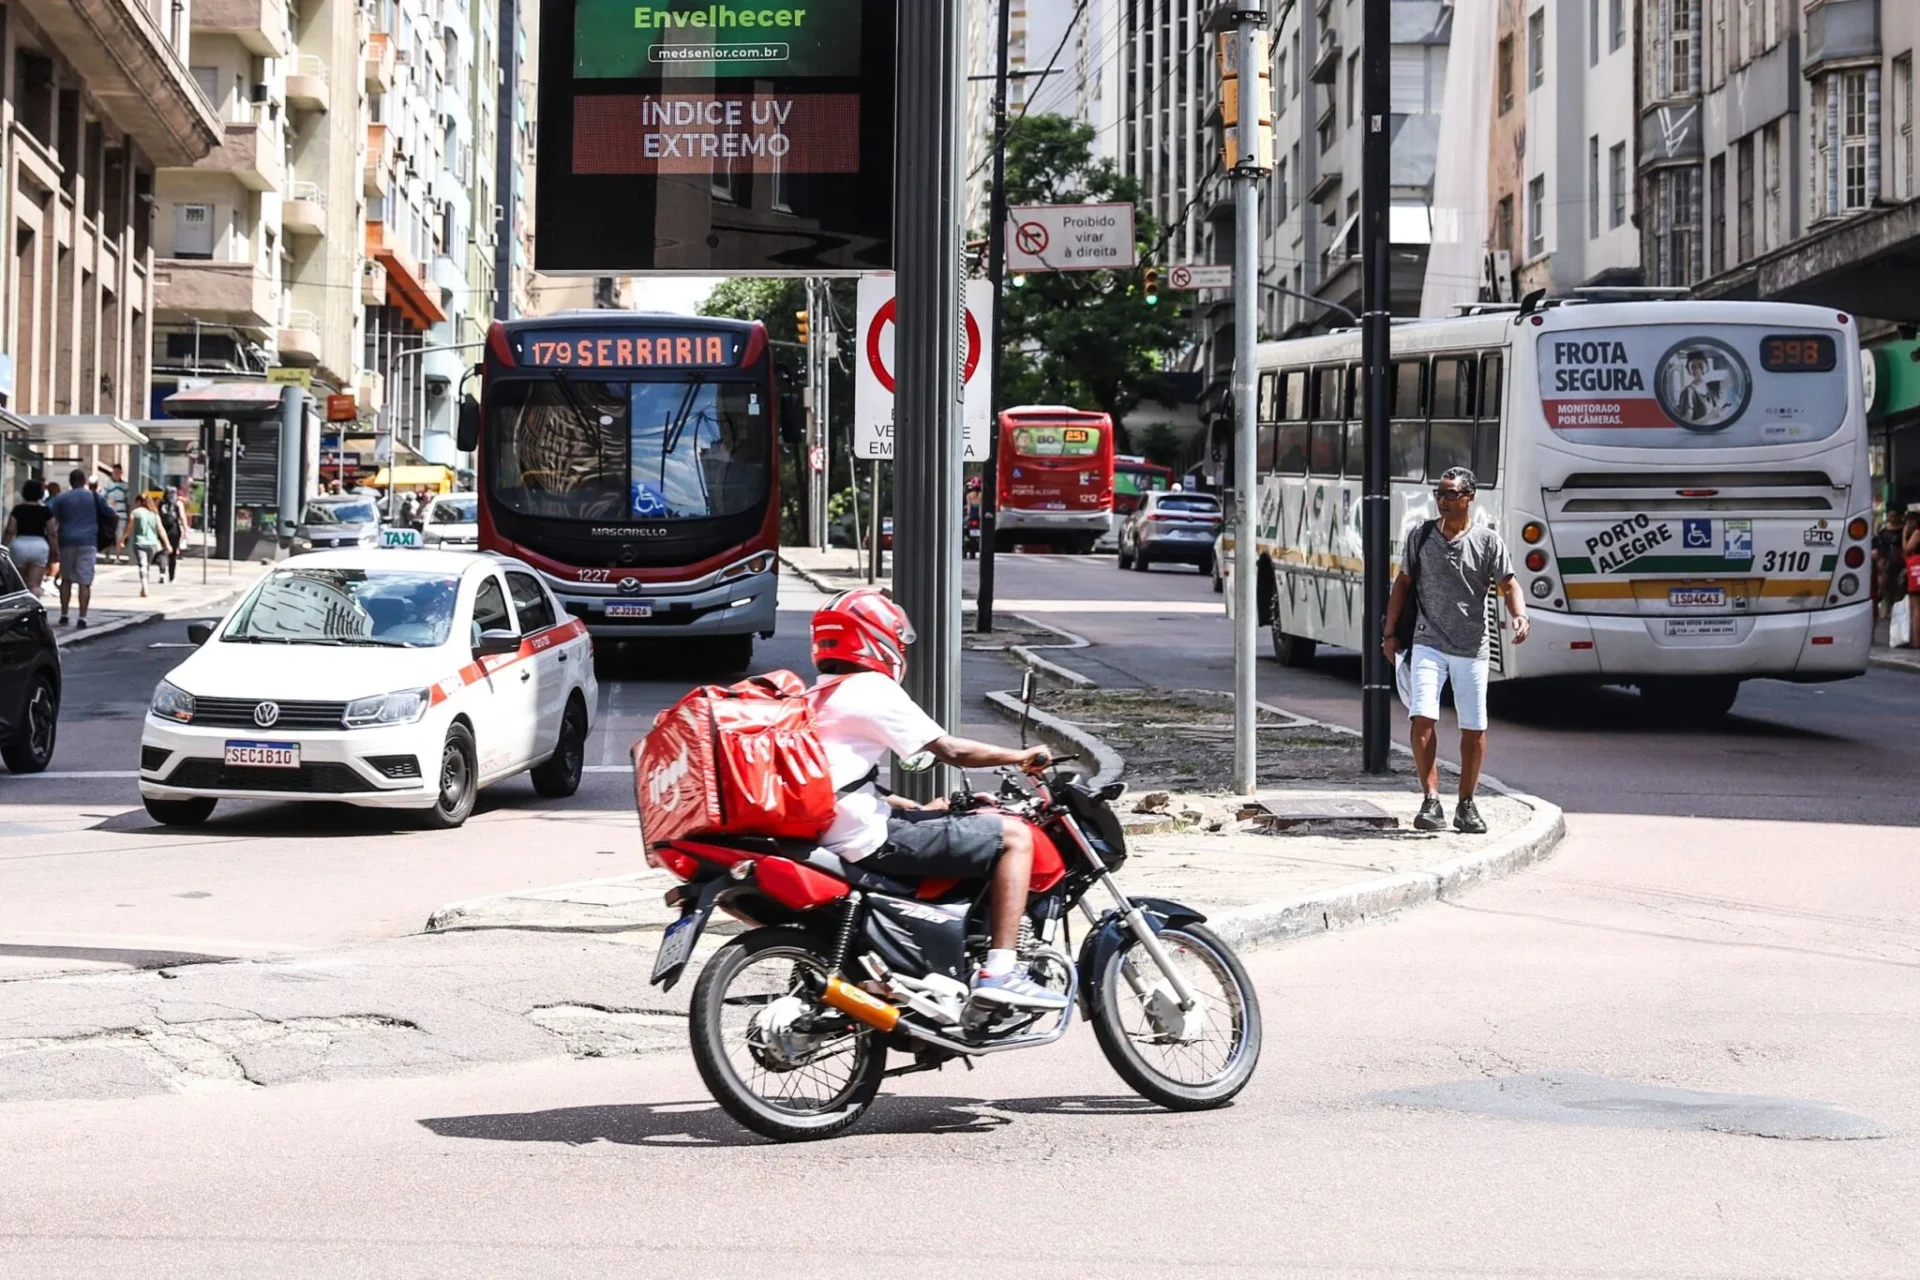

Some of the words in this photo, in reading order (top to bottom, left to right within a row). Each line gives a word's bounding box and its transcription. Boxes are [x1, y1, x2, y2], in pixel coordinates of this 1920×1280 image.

[634, 5, 806, 29] Envelhecer
[658, 47, 778, 59] medsenior.com.br
[642, 95, 743, 126] ÍNDICE
[751, 100, 793, 125] UV
[643, 133, 790, 158] EXTREMO
[1063, 216, 1116, 228] Proibido
[1075, 233, 1104, 243] virar
[1064, 246, 1072, 258] à
[1076, 245, 1117, 258] direita
[532, 341, 572, 365] 179
[577, 336, 723, 367] SERRARIA
[1554, 341, 1628, 365] FROTA
[1769, 339, 1819, 365] 398
[1555, 368, 1645, 392] SEGURA
[1557, 404, 1620, 414] MONITORADO
[1558, 415, 1576, 425] POR
[1577, 413, 1623, 425] CÂMERAS.
[1065, 431, 1087, 442] 251
[1079, 494, 1098, 503] 1212
[384, 532, 416, 546] TAXI
[591, 527, 667, 537] MASCARELLO
[1585, 513, 1650, 555] PORTO
[1597, 522, 1673, 574] ALEGRE
[1762, 550, 1811, 572] 3110
[577, 569, 611, 582] 1227
[231, 748, 292, 765] SEC1B10
